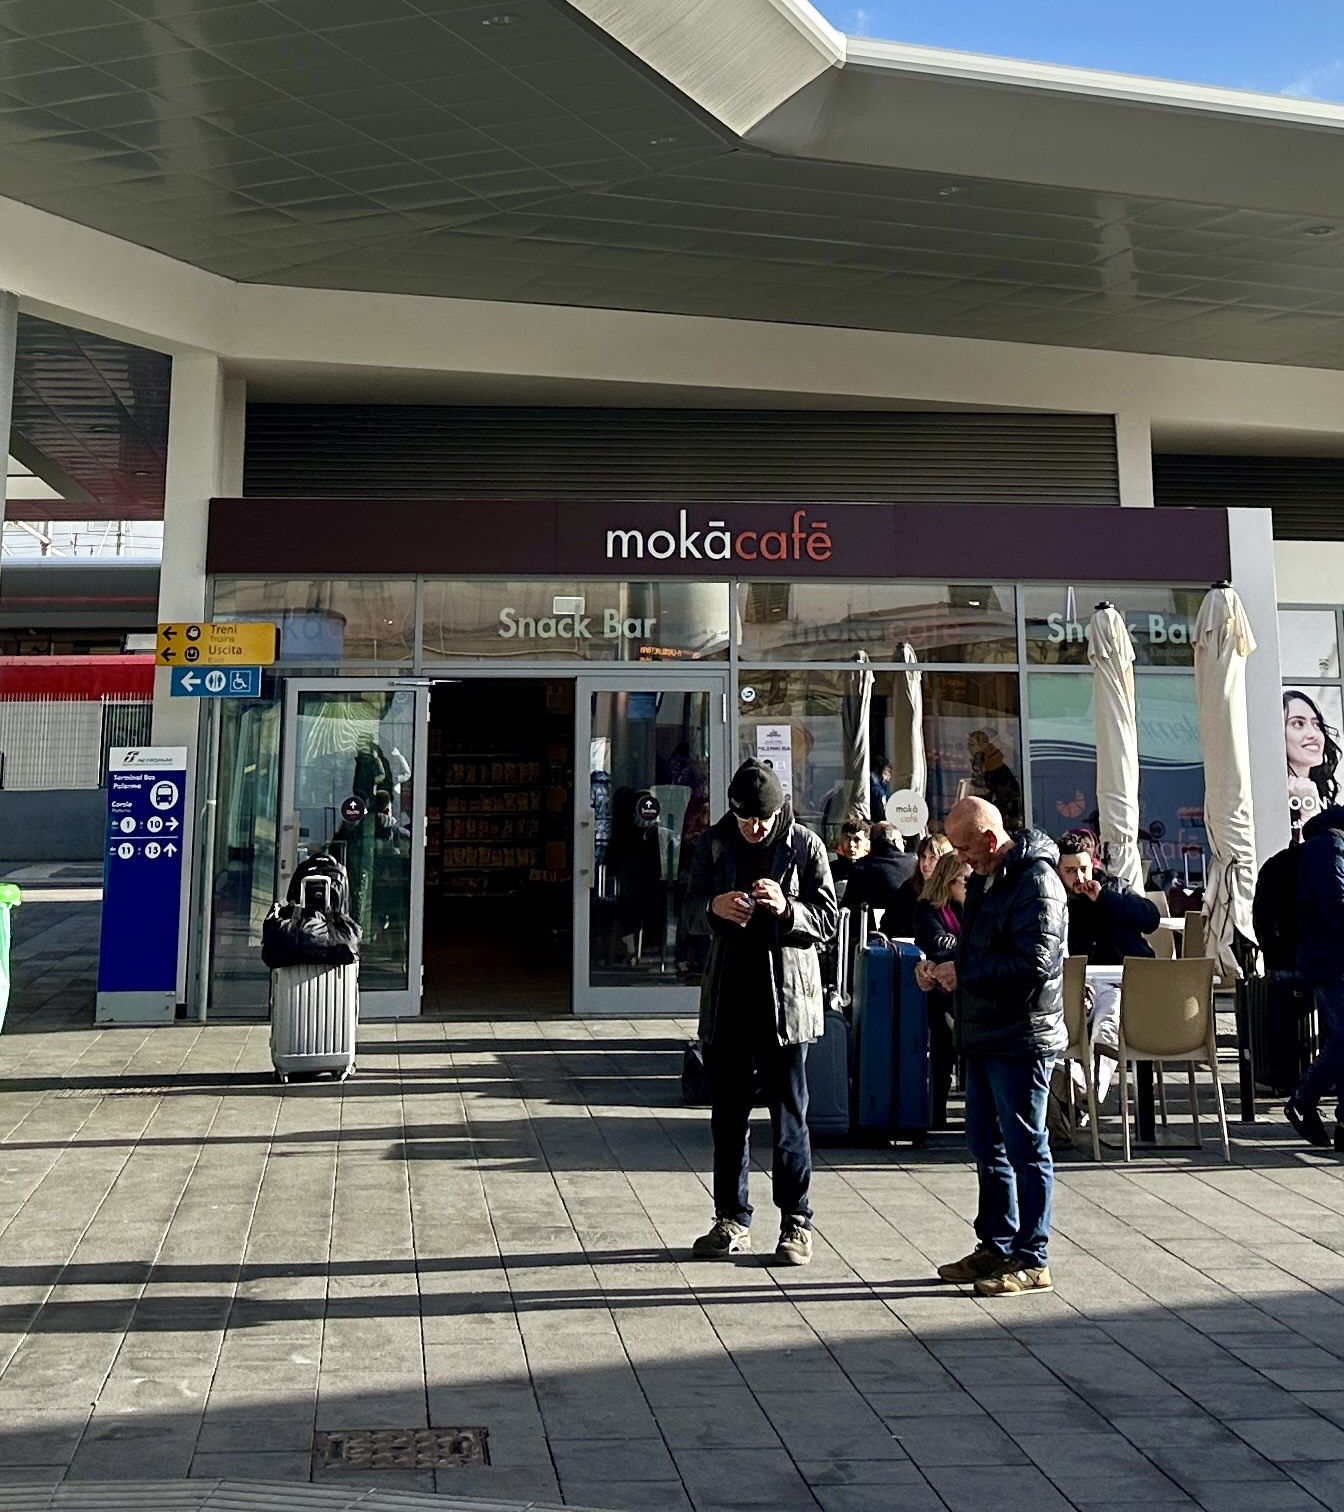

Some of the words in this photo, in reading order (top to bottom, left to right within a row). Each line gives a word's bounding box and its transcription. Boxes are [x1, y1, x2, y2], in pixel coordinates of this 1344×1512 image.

[498, 607, 592, 638] Snack
[604, 608, 657, 638] Bar
[1047, 612, 1139, 643] Snk
[211, 625, 237, 634] Treni
[208, 645, 242, 655] Uscita
[1288, 795, 1328, 810] OON
[150, 820, 161, 829] 10
[122, 847, 131, 855] 11
